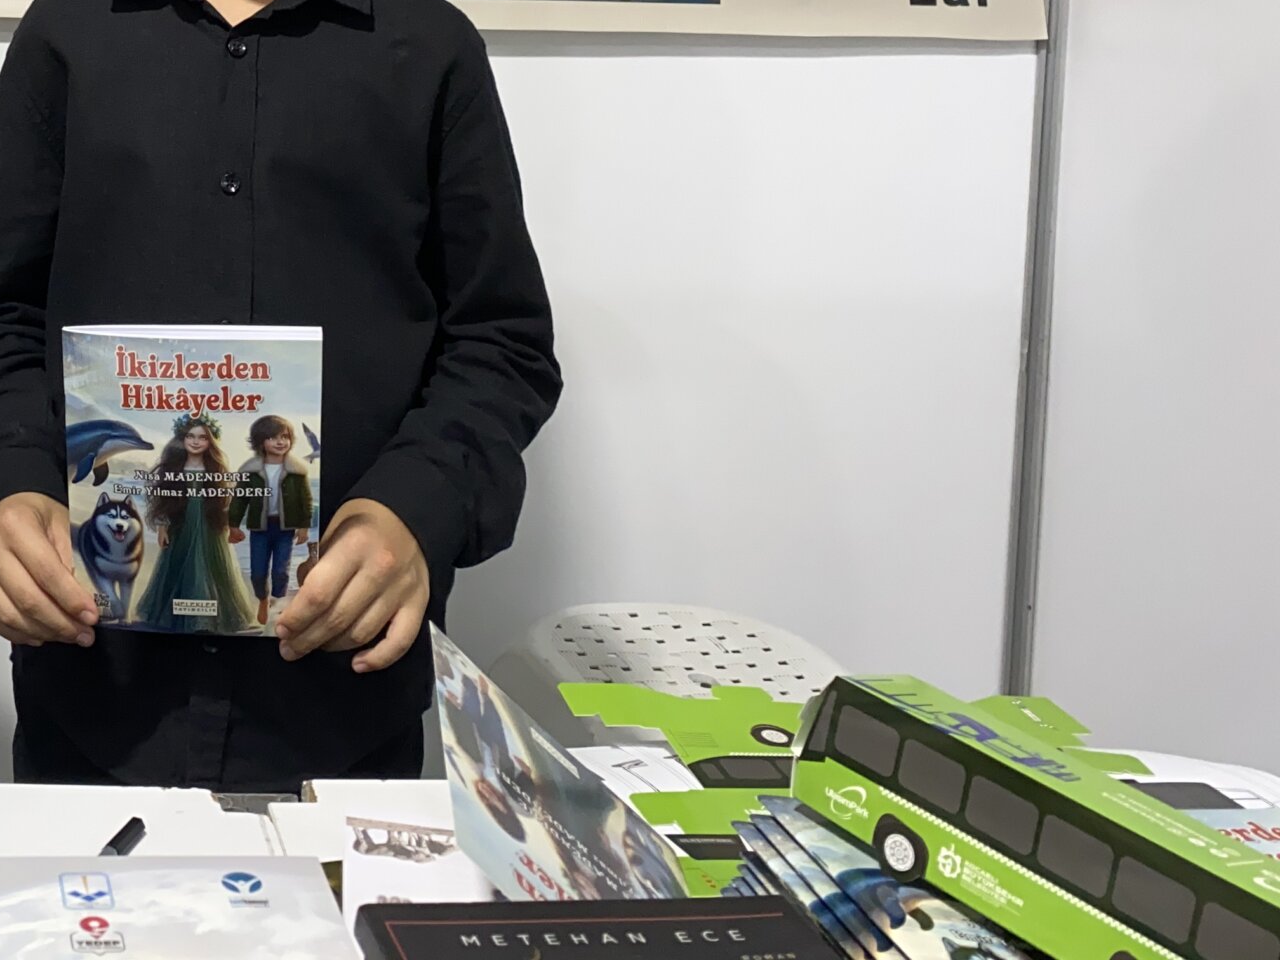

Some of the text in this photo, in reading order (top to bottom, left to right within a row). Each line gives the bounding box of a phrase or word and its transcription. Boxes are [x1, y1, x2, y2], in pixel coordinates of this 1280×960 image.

[115, 344, 272, 381] İkizlerden
[120, 383, 264, 419] Hikâyeler
[134, 469, 251, 483] Nisa MADENDERE
[113, 483, 273, 498] Emir Yılmaz MADENDERE
[460, 928, 746, 947] METEHAN ECE
